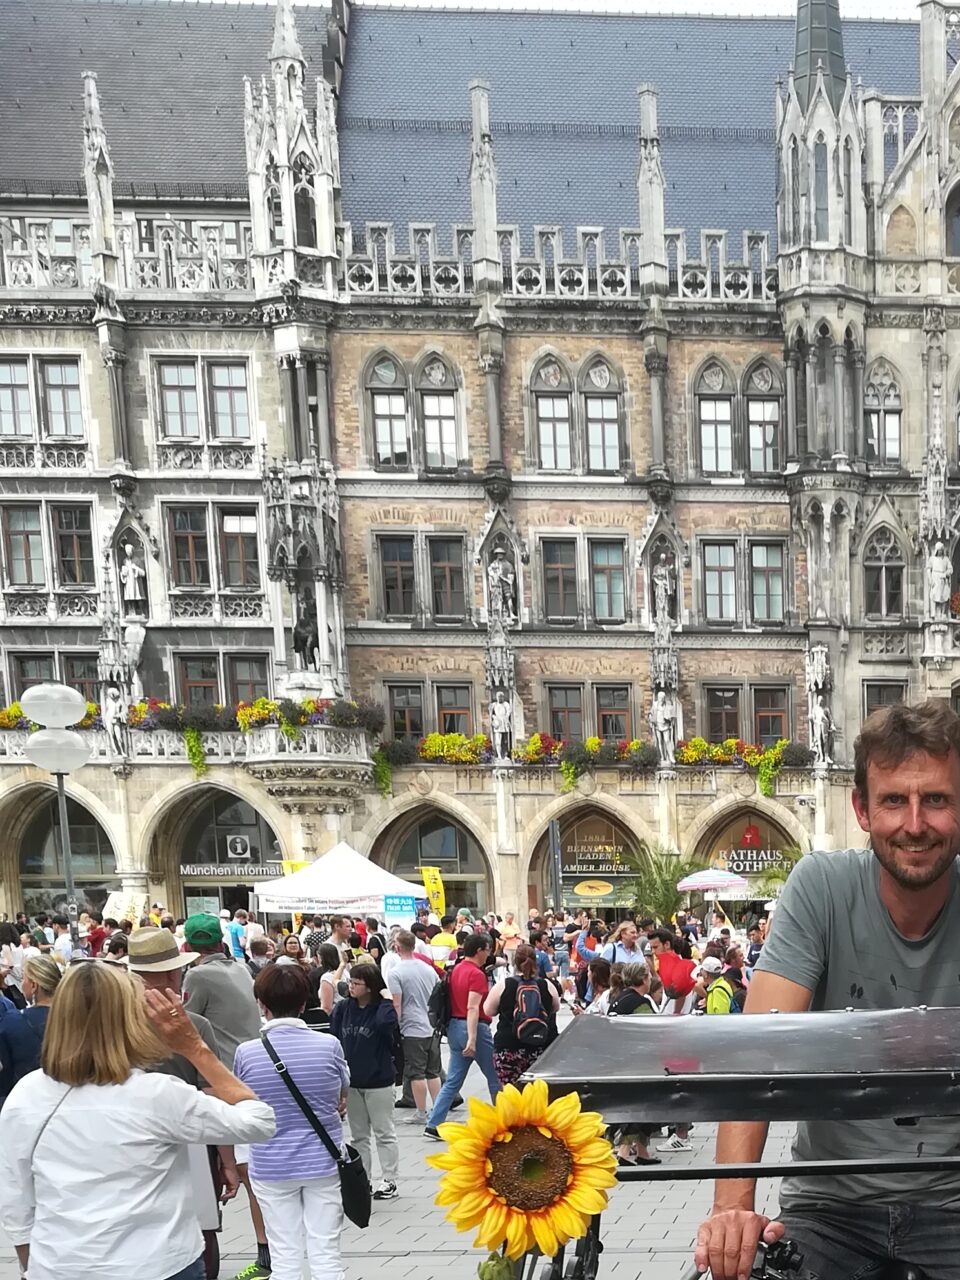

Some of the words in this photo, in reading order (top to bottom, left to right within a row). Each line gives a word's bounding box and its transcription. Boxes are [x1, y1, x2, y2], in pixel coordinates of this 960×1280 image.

[720, 849, 783, 860] RATHAUS
[180, 865, 231, 876] München
[563, 864, 595, 872] AMBER
[599, 864, 631, 872] HOUSE
